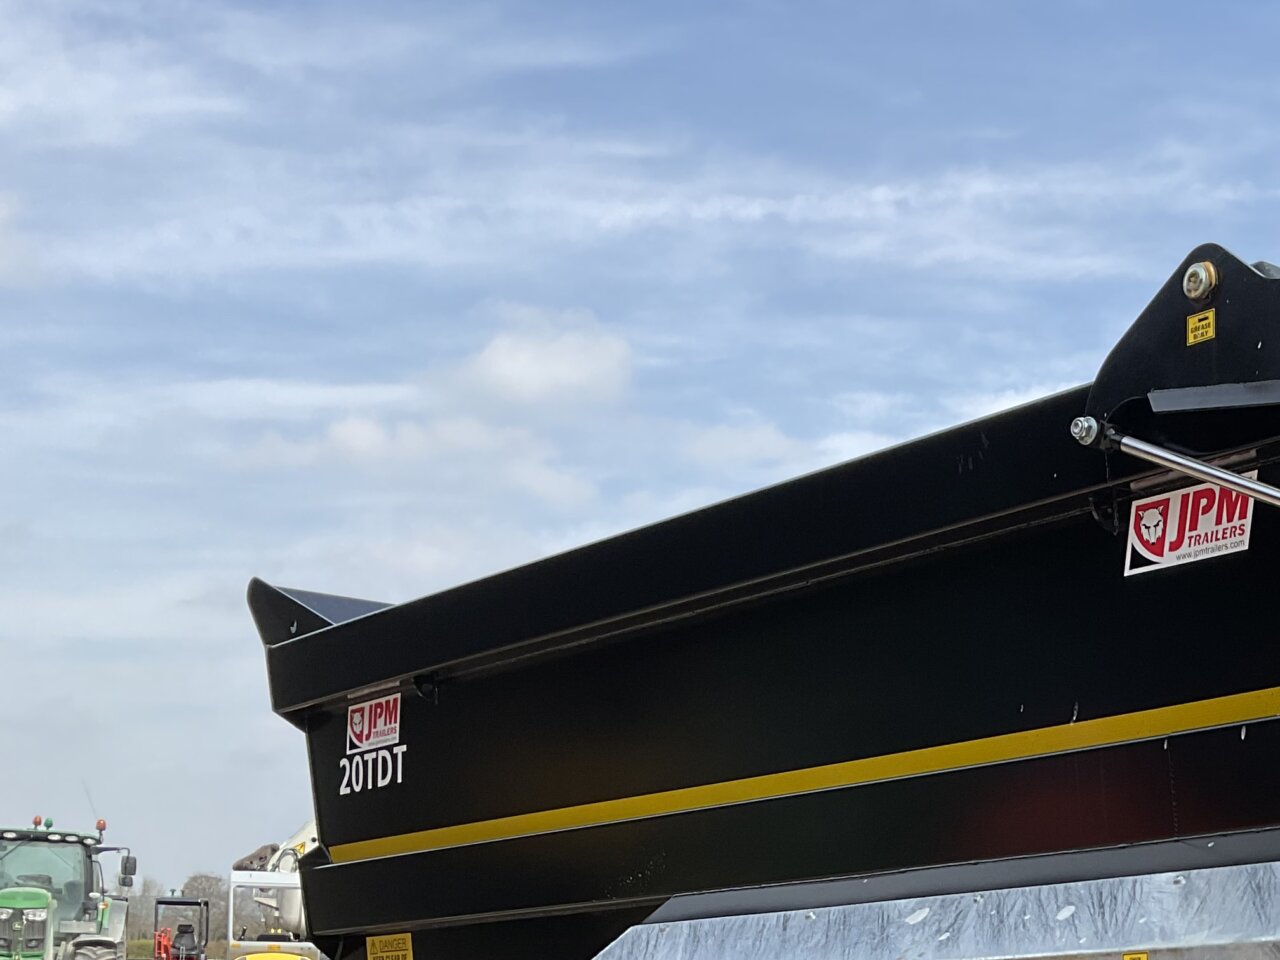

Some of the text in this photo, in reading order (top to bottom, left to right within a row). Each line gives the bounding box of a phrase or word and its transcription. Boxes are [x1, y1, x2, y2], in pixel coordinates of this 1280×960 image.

[1168, 485, 1250, 552] JPM
[1187, 523, 1246, 548] TRAILERS
[1175, 539, 1246, 561] www.jpmtrailers.com
[364, 697, 399, 742] JPM
[372, 725, 397, 739] TRAILERS
[339, 744, 407, 795] 20TDT
[379, 938, 406, 950] DANGER
